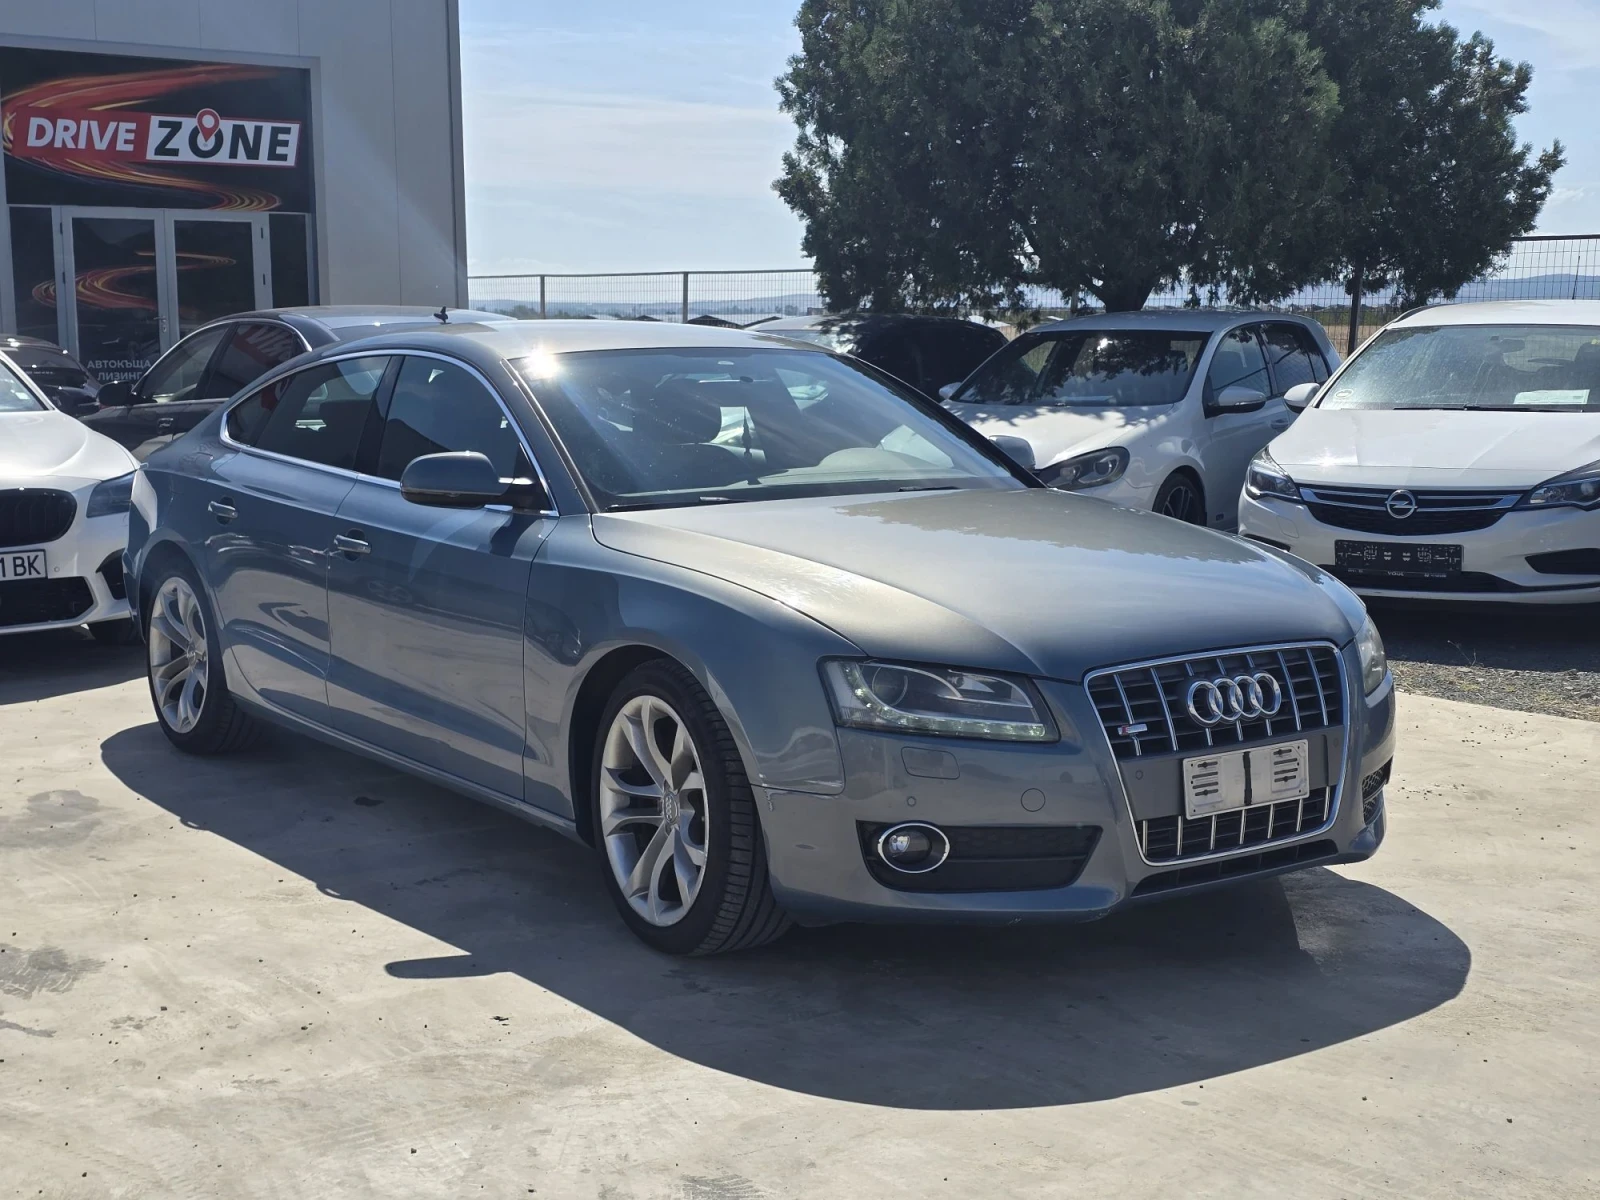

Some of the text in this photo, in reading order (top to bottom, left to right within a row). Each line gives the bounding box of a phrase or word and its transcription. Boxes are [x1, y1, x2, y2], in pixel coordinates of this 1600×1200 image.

[26, 117, 292, 162] DRIVE ZONE
[86, 359, 152, 370] АВТОКЪЩА
[97, 371, 143, 381] ЛИЗИНГ
[12, 554, 41, 577] BK
